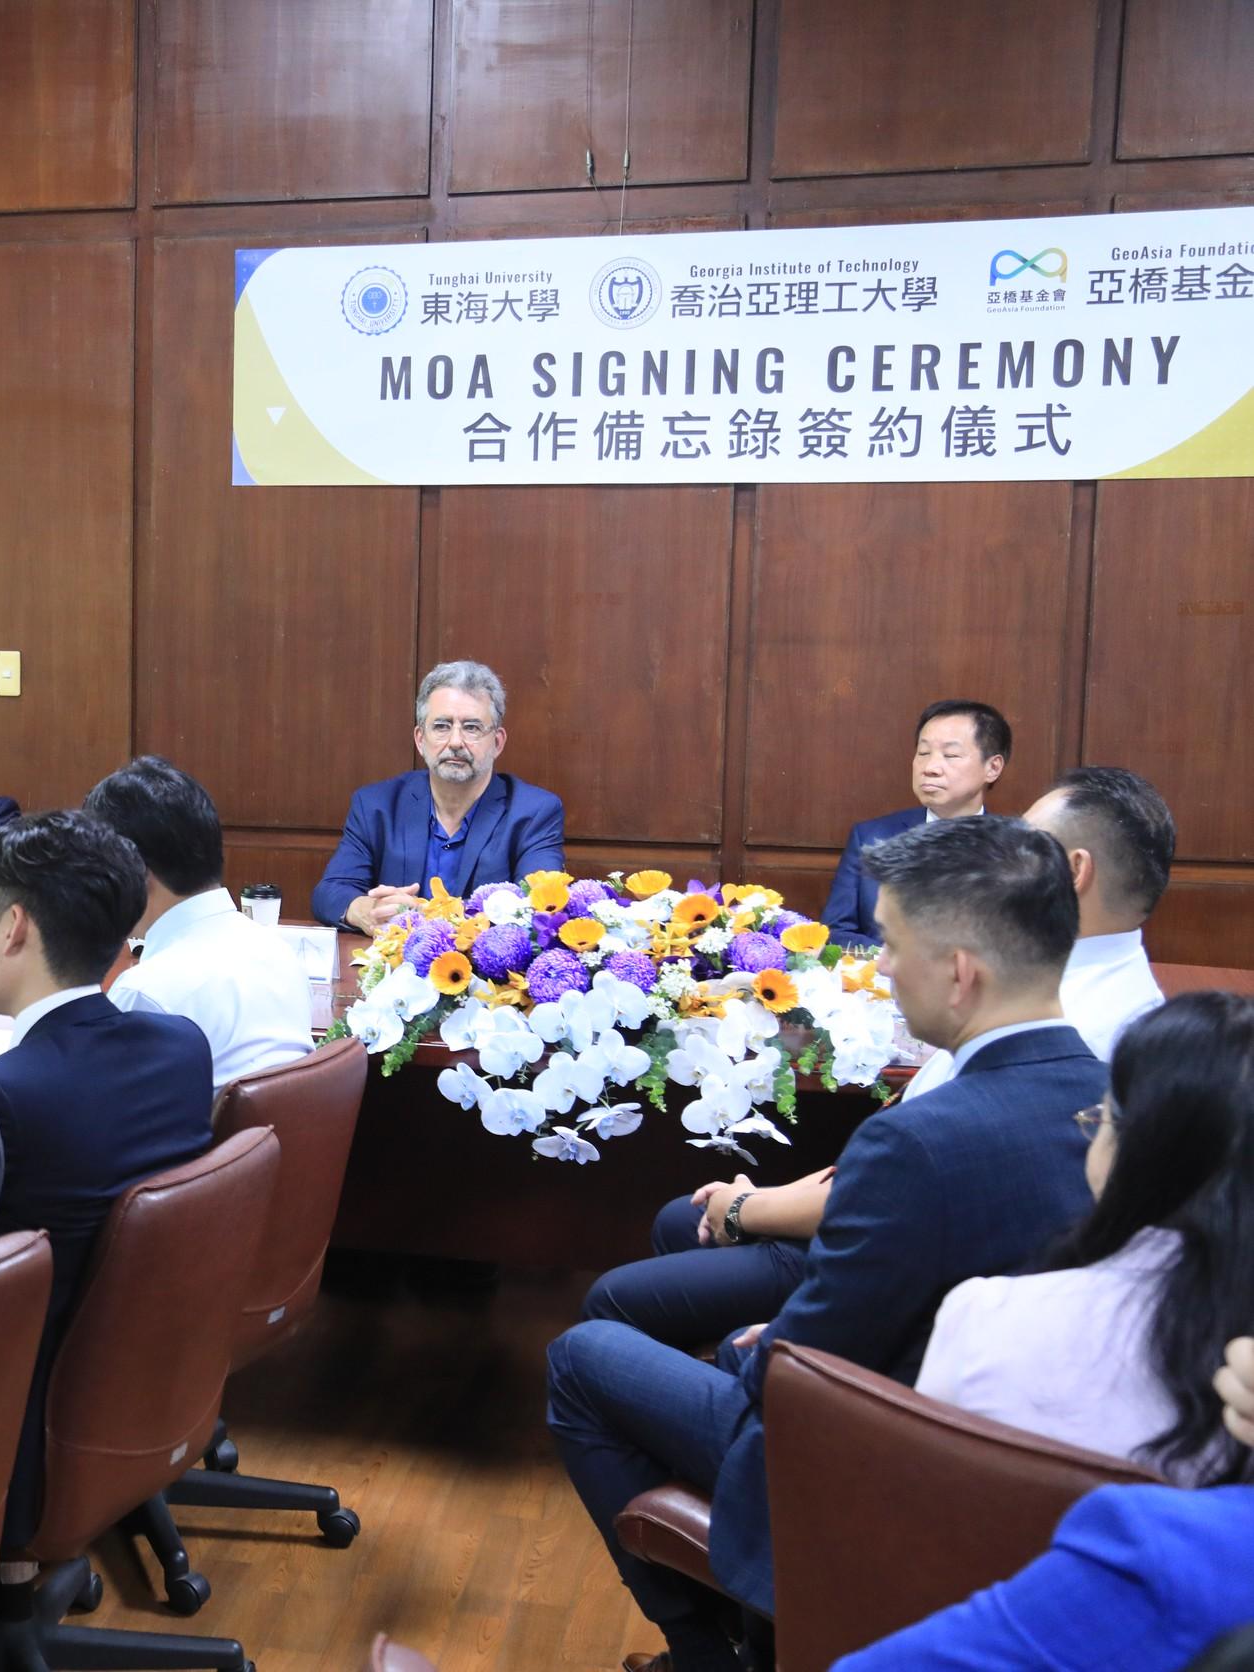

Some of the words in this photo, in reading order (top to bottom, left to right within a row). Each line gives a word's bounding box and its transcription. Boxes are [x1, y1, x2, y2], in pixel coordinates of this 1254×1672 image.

[689, 264, 743, 280] Georgia
[749, 261, 811, 276] Institute
[817, 260, 832, 274] of
[837, 257, 919, 276] Technology
[1111, 245, 1173, 262] GeoAsia
[428, 272, 479, 288] Tunghai
[485, 269, 553, 286] University
[1086, 262, 1254, 305] 亞橋基金
[420, 288, 560, 326] 東海大學
[670, 275, 938, 319] 喬治亞理工大學
[986, 288, 1067, 304] 亞橋基金會
[986, 305, 1019, 314] GeoAsia
[1020, 304, 1066, 313] Foundation
[380, 353, 494, 401] MOA
[532, 347, 785, 399] SIGNING
[826, 335, 1181, 394] CEREMONY
[462, 402, 1072, 463] 合作備忘錄簽約儀式
